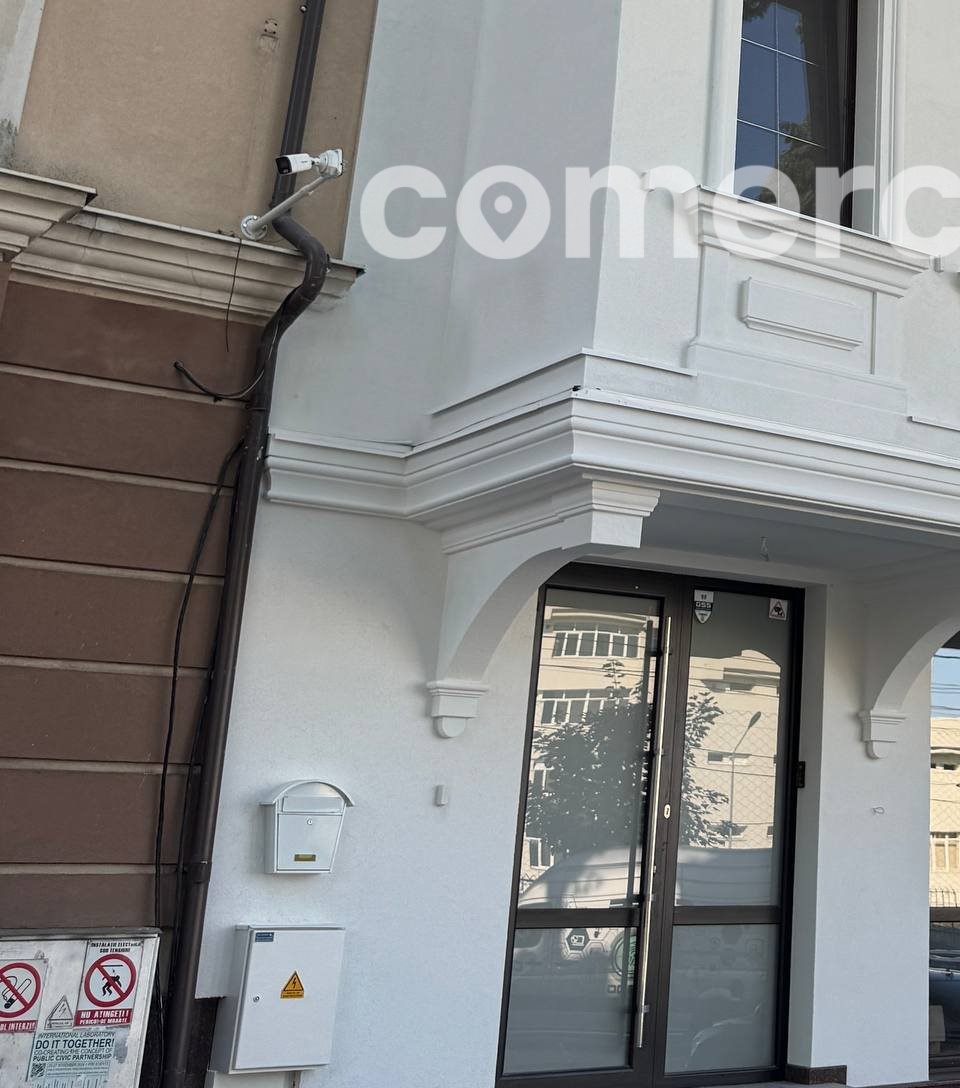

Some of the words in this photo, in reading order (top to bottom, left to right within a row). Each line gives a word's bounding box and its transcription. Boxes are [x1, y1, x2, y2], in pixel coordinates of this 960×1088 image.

[81, 1011, 91, 1019] NU
[35, 1040, 49, 1049] DO
[51, 1040, 61, 1049] IT
[63, 1038, 115, 1048] TOGETHER!
